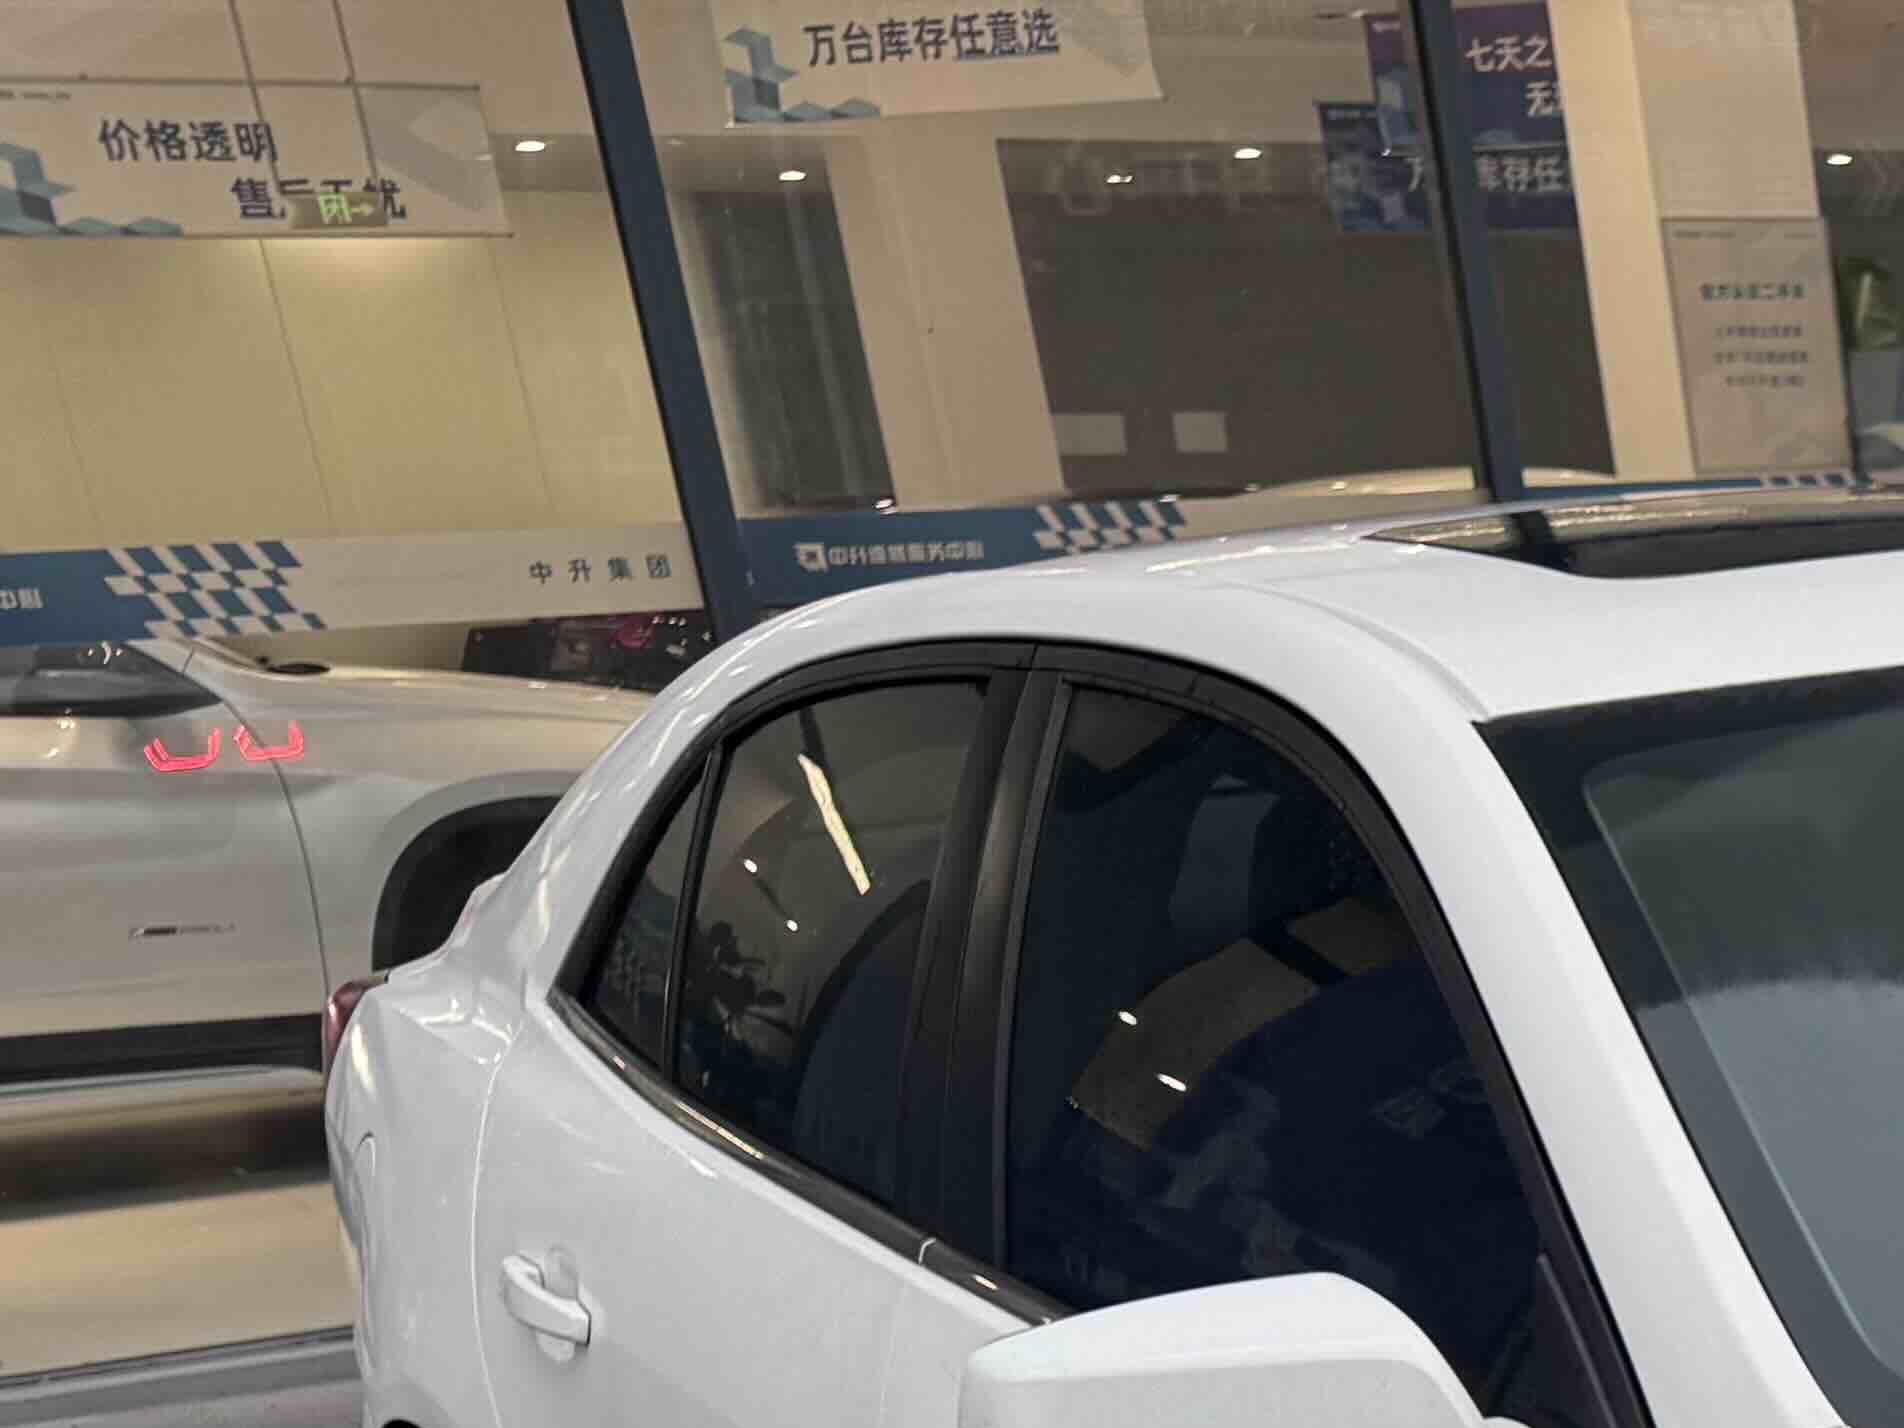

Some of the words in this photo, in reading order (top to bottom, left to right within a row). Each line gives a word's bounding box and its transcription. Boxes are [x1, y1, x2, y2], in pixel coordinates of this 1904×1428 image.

[802, 8, 1060, 67] 万台库存任意选
[98, 119, 279, 163] 价格透明
[528, 554, 671, 585] 中升集团
